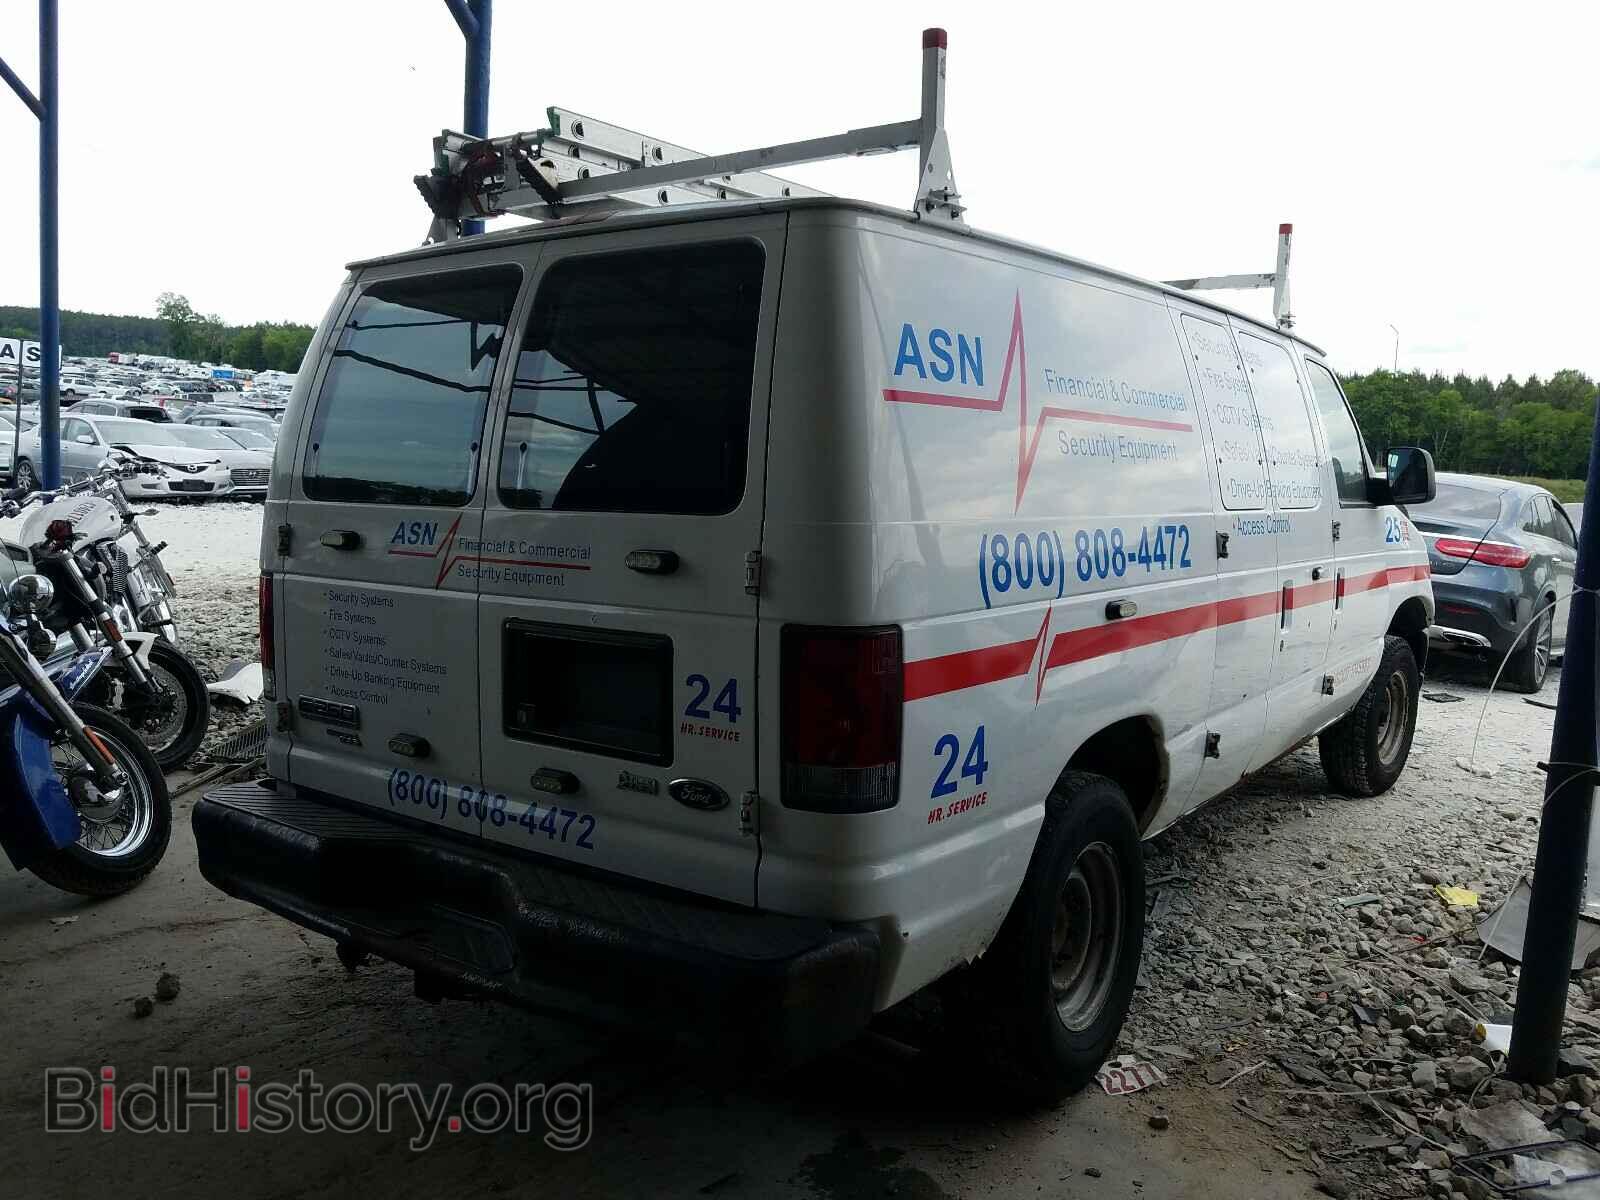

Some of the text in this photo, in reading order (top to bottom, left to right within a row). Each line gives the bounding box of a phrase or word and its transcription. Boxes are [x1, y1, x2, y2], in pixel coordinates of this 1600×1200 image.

[893, 322, 985, 387] ASN
[1044, 367, 1187, 412] Financial & Commercial
[1057, 430, 1177, 465] Security Equipment
[391, 521, 439, 546] ASN
[1237, 514, 1291, 536] Access Control
[458, 537, 591, 561] Financial & Commercial
[979, 524, 1192, 609] (800) 808-4472
[457, 565, 565, 586] Security Equipment
[684, 673, 741, 723] 24
[698, 725, 740, 742] SERVICE
[930, 725, 989, 799] 24
[387, 767, 597, 851] (800) 808-4472
[928, 791, 988, 825] HR. SERVICE
